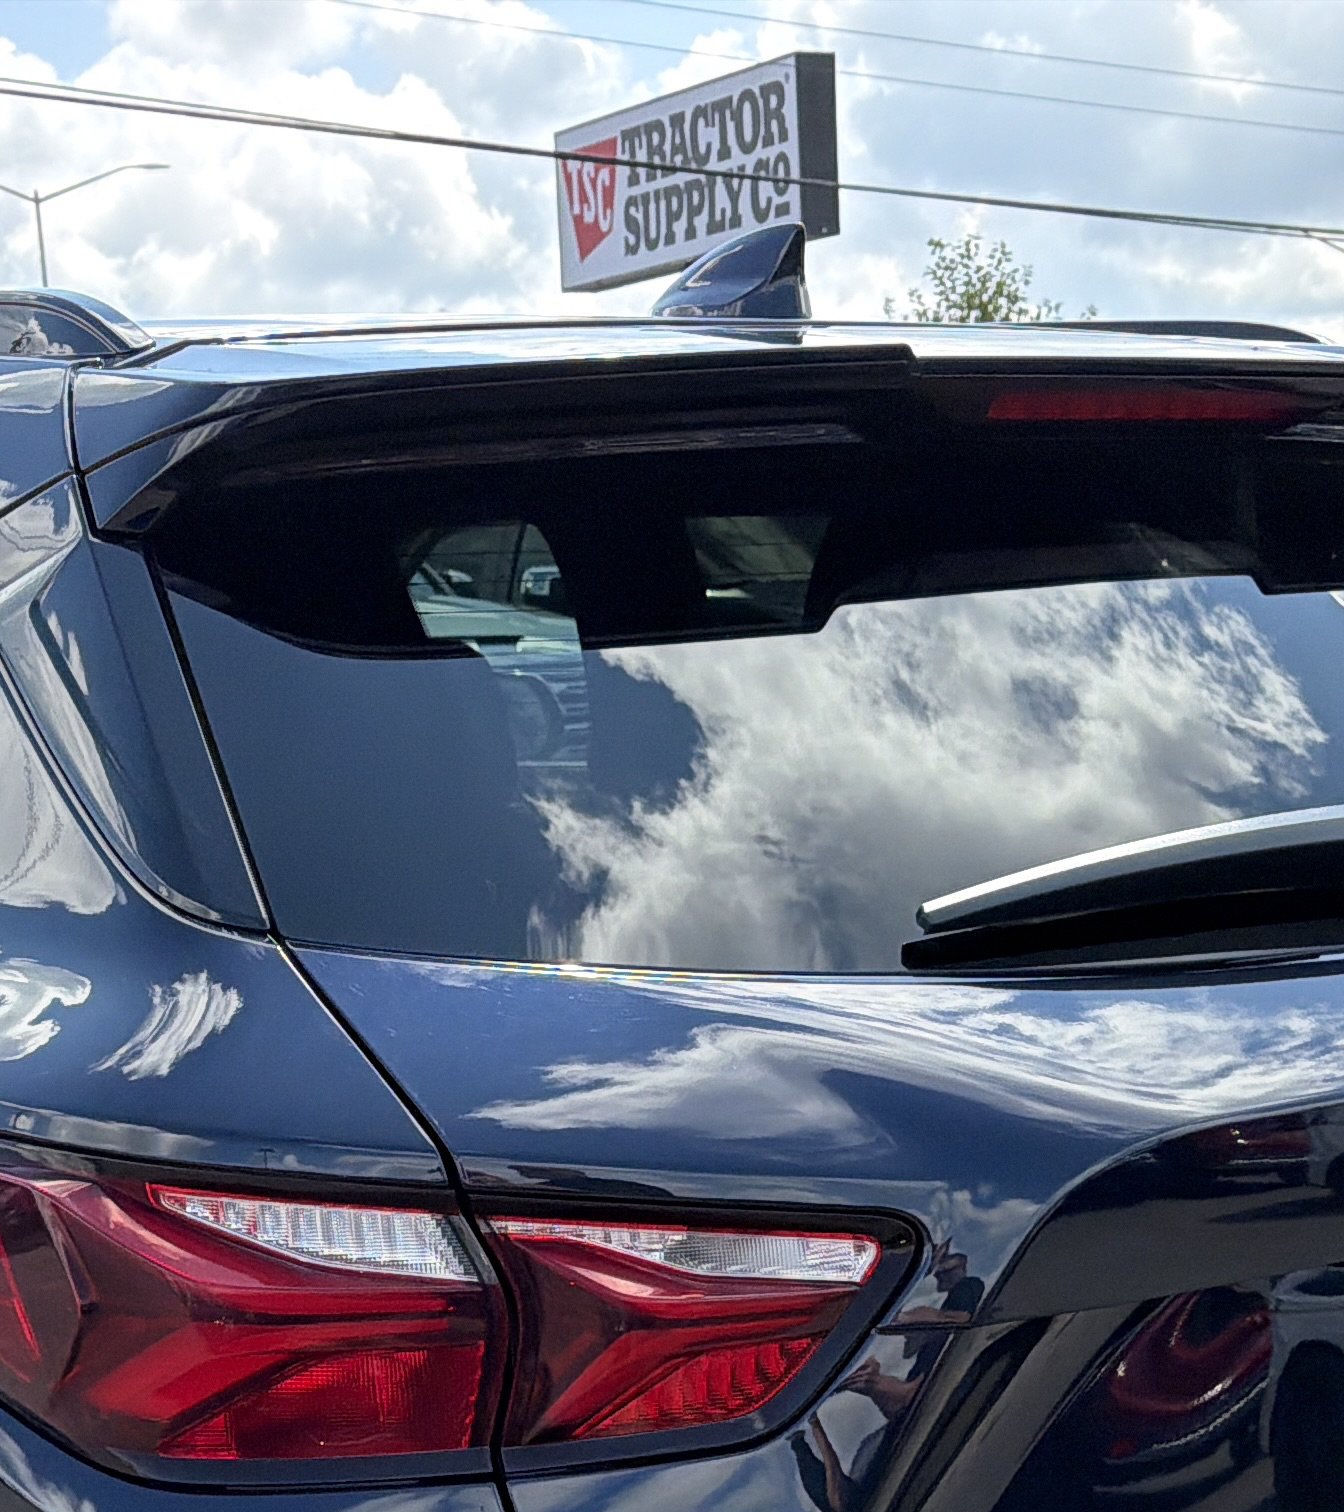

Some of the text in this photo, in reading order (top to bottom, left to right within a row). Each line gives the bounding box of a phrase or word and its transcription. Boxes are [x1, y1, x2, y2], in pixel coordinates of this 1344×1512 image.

[621, 80, 789, 188] TRACTOR
[567, 157, 611, 233] TSC
[624, 164, 746, 256] SUPPLY
